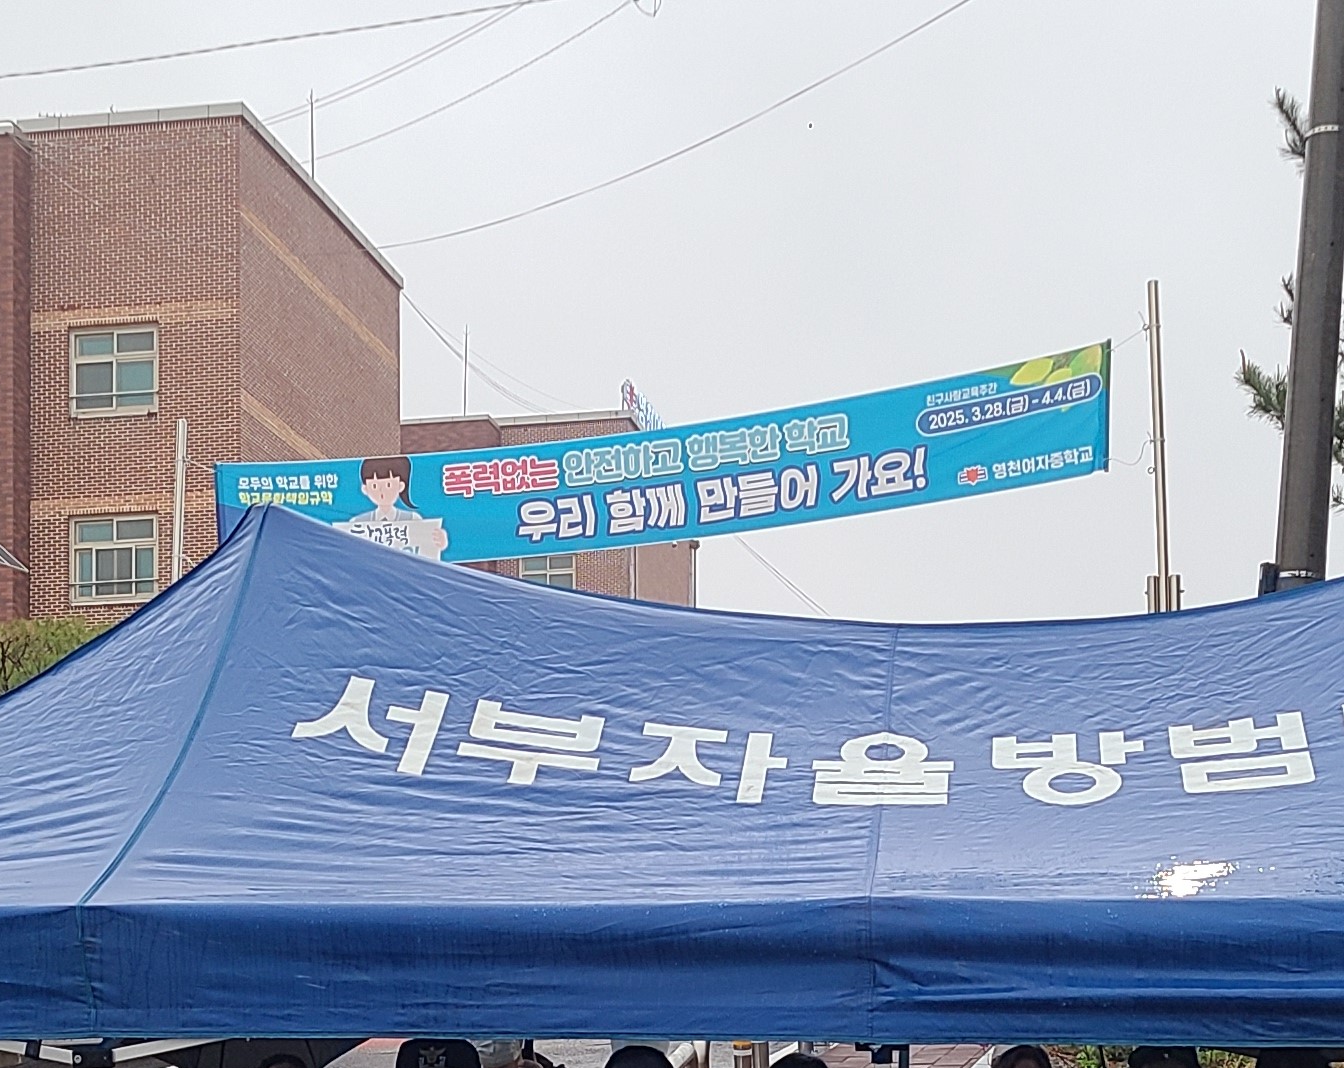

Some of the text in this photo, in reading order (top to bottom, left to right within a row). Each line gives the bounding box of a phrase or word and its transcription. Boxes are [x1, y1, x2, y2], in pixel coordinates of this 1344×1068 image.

[926, 383, 998, 407] 친구사랑교육주간
[928, 409, 969, 430] 2025.
[972, 395, 1029, 422] 3.28.(금)
[1042, 379, 1091, 405] 4.4.(금)
[443, 413, 851, 497] 폭력없는 안전하고 행복한 학교
[992, 446, 1094, 480] 영천여자중학교
[238, 474, 339, 491] 모두의 학교를 위한
[518, 446, 927, 542] 우리 함께 만들어 가요!
